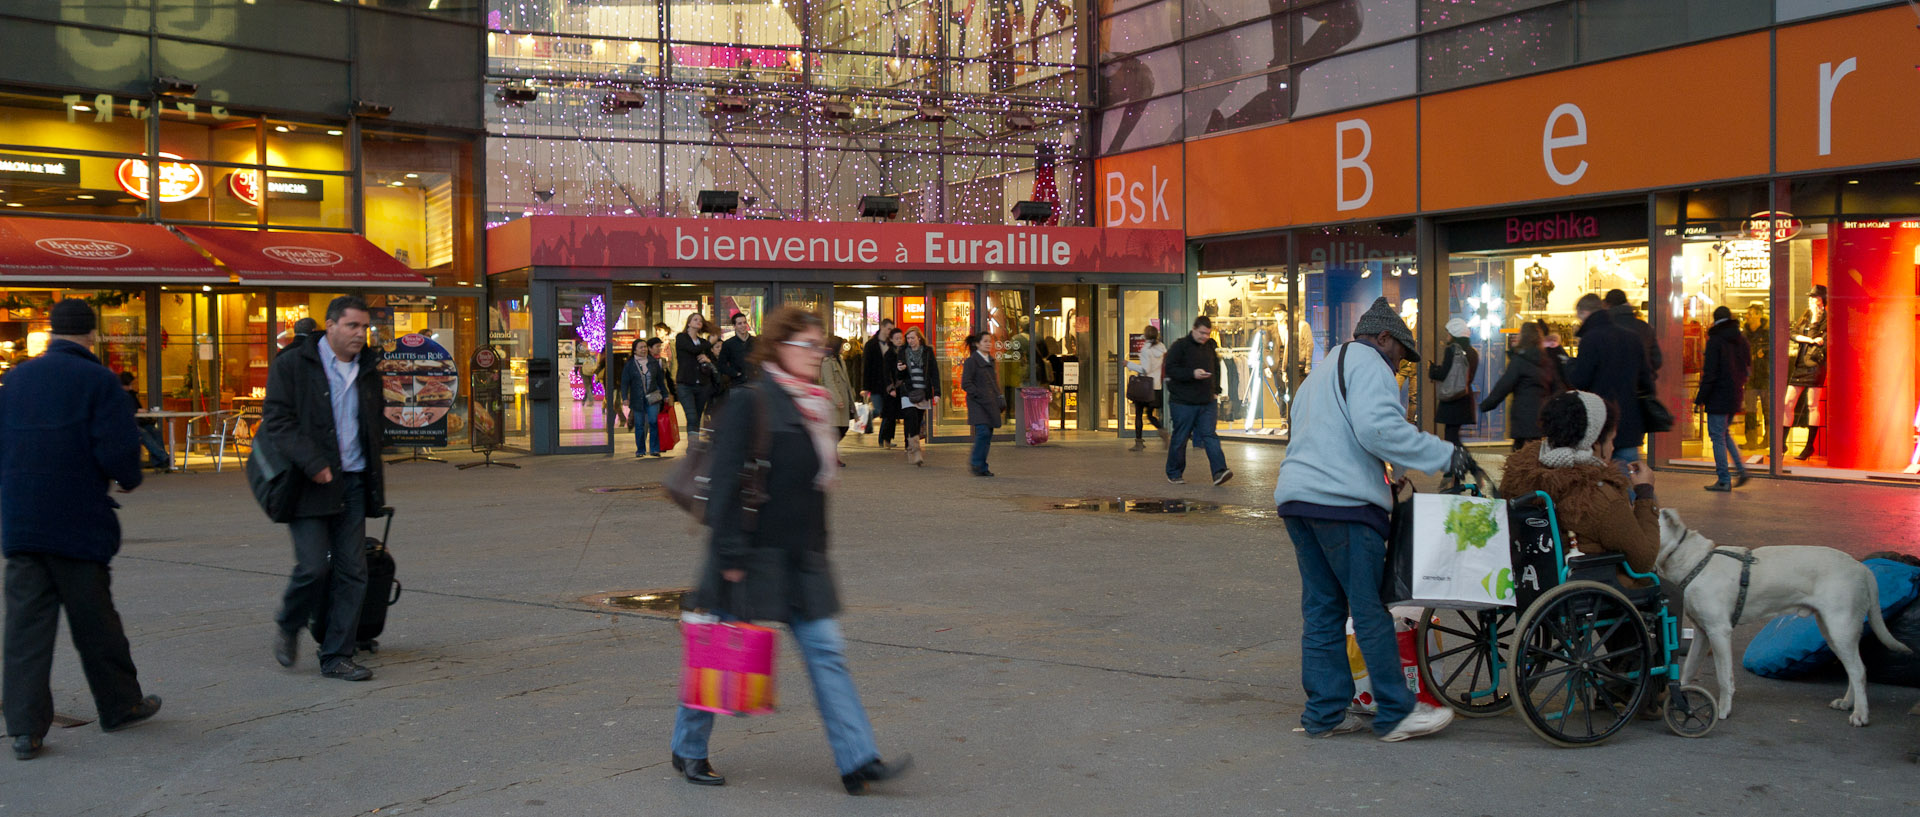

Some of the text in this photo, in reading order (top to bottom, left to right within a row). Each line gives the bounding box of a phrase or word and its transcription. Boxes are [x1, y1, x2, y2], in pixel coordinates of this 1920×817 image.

[554, 42, 593, 55] CLUB
[132, 159, 195, 182] Broche
[1107, 165, 1169, 228] Bsk
[1506, 212, 1600, 244] Bershka
[45, 240, 118, 251] Brioche
[676, 227, 1070, 266] bienvenue à Euralille
[904, 304, 925, 313] HEM
[383, 351, 416, 360] GALETTES
[427, 351, 443, 360] ROIS
